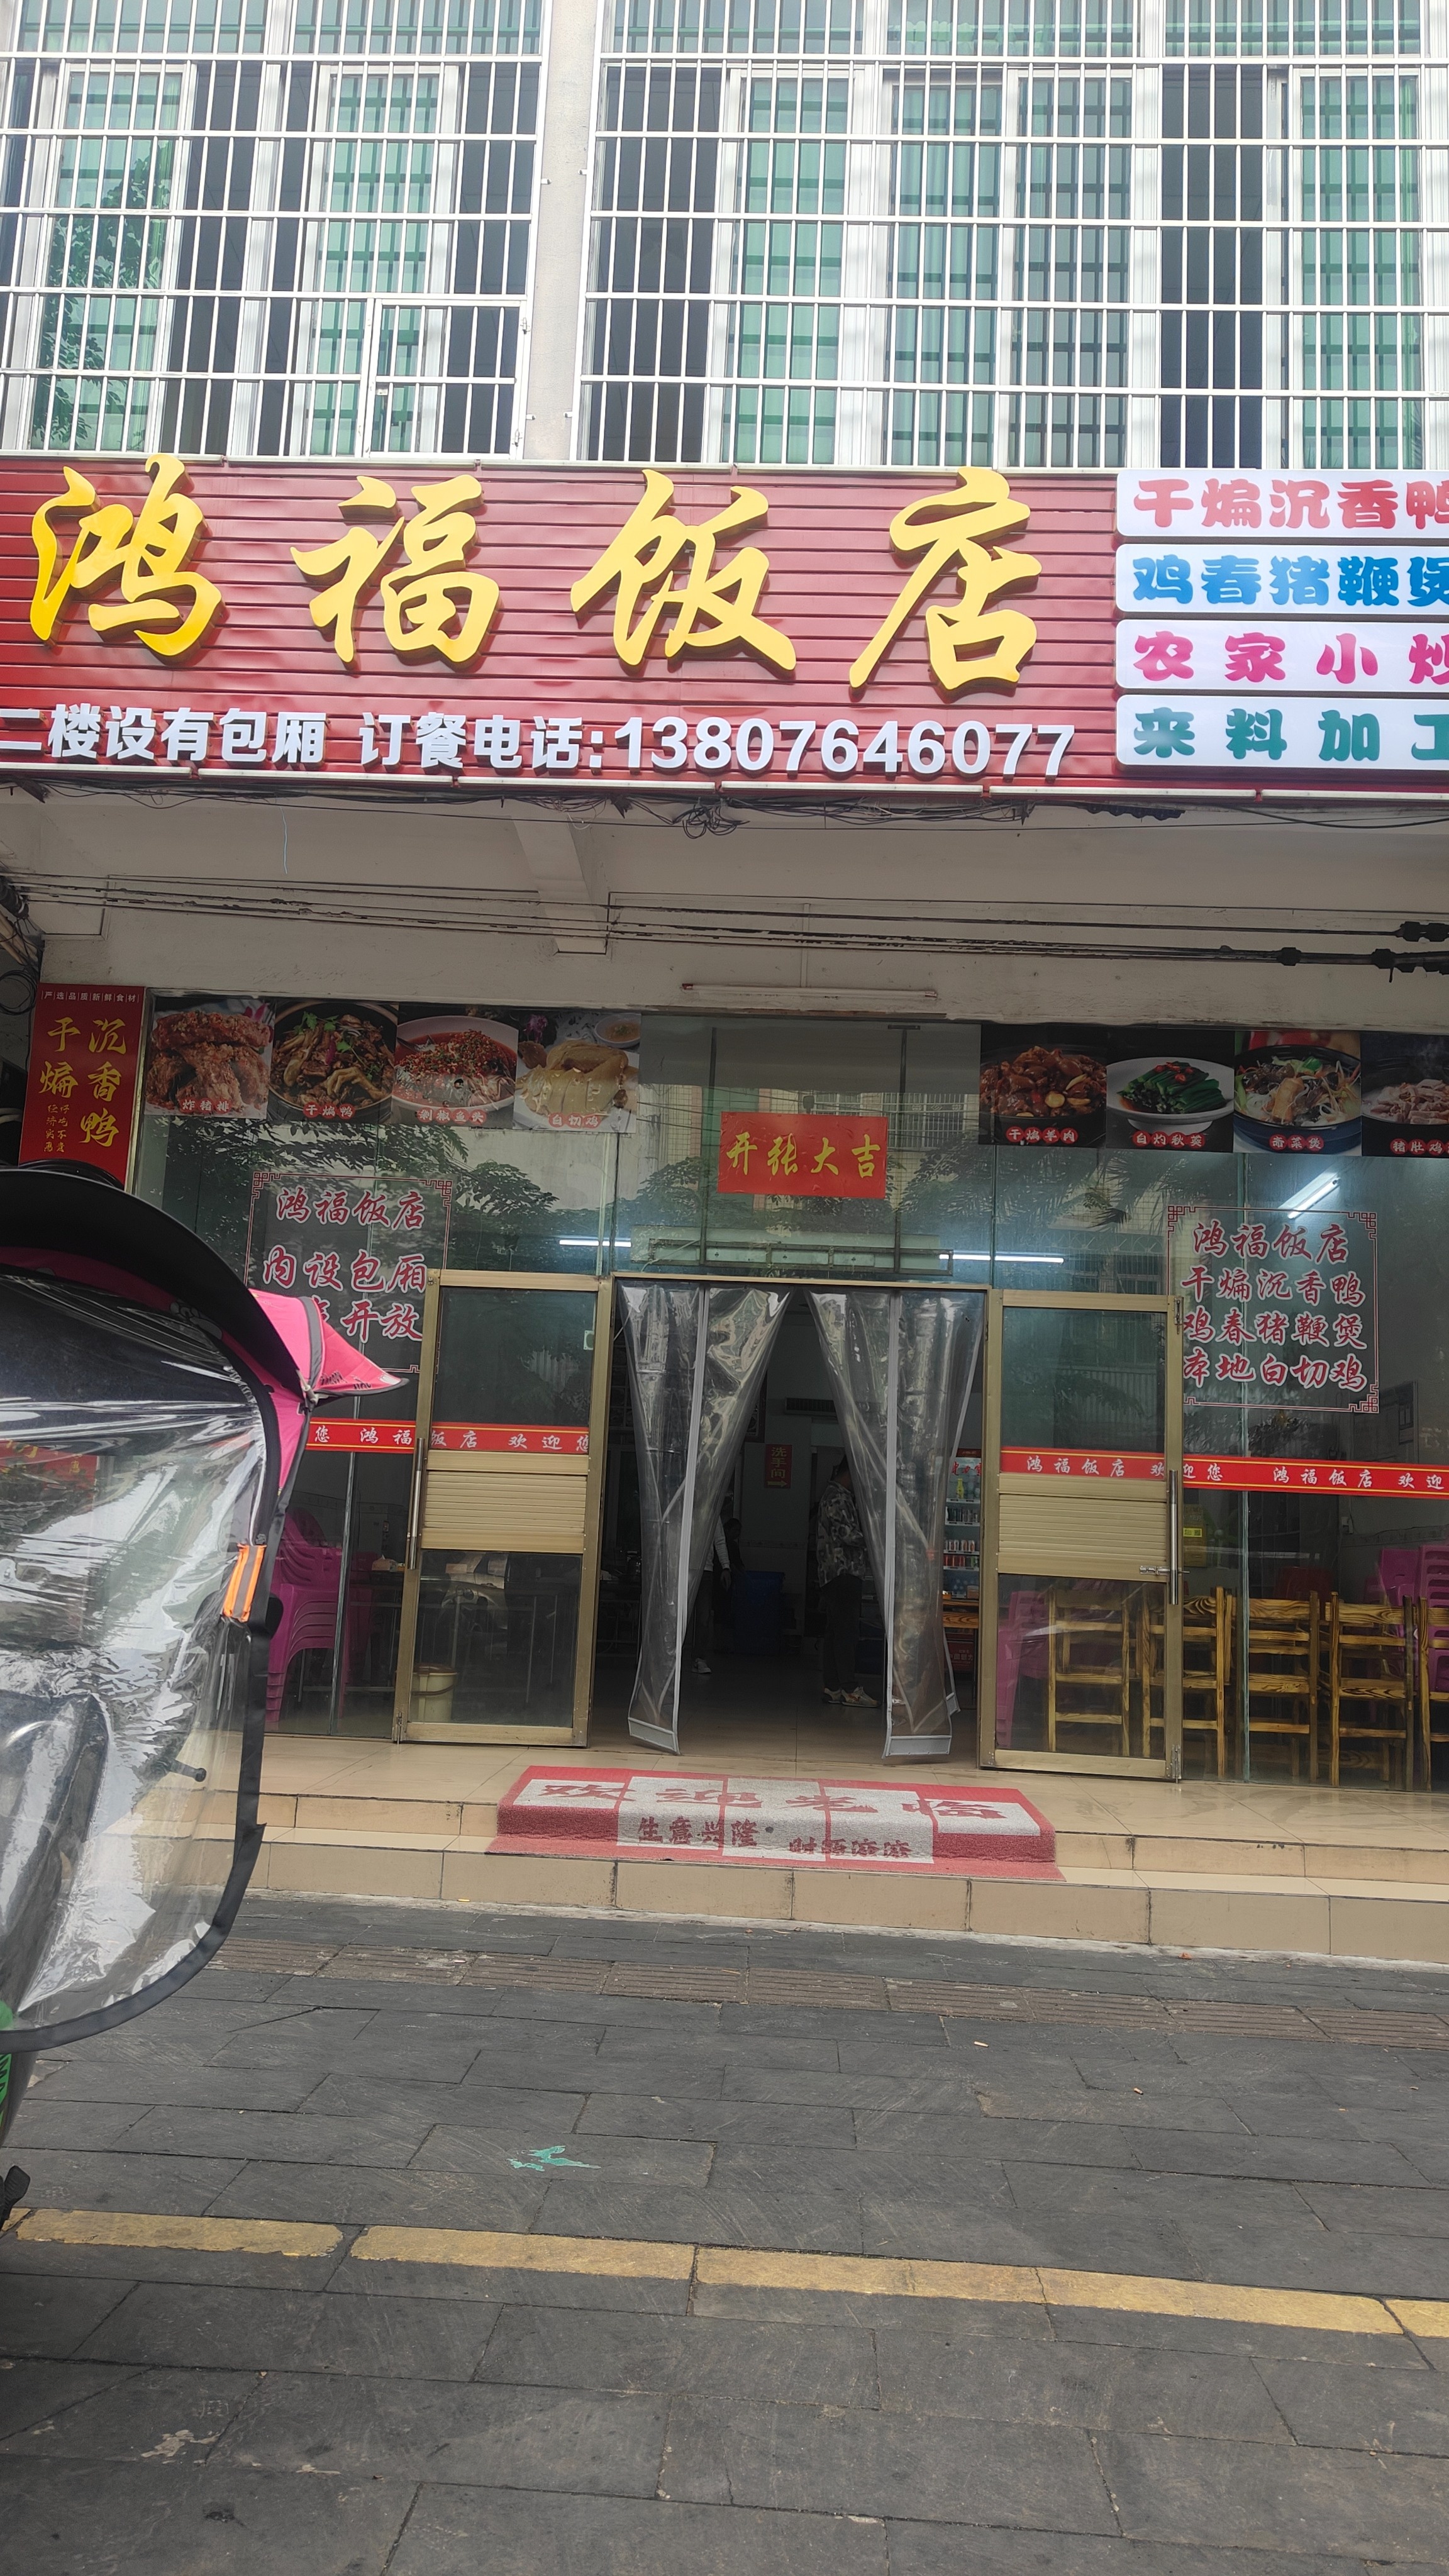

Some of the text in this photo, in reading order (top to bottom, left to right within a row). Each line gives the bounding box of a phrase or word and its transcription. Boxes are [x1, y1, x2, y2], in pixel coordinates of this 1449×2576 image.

[1133, 478, 1449, 530] 干煸沉香鸭
[30, 453, 1043, 689] 鸿福饭店
[1133, 554, 1449, 606] 鸡春猪鞭煲
[1133, 631, 1449, 684] 农家小炒
[0, 702, 327, 763] 二楼设有包厢
[1133, 708, 1449, 761] 来料加工
[182, 1099, 229, 1112] 炸猪排
[419, 1109, 484, 1123] 剁椒鱼头
[553, 1114, 599, 1127] 白切鸡
[727, 1131, 880, 1179] 开张大吉
[1136, 1133, 1202, 1147] 白灼秋葵
[1392, 1140, 1449, 1155] 猪肚鸡
[276, 1186, 426, 1231] 鸿福饭店
[1192, 1219, 1349, 1264] 鸿福饭店
[263, 1245, 428, 1294] 内设包厢
[1181, 1267, 1366, 1307] 干煸沉香鸭
[1183, 1307, 1367, 1350] 鸡春猪鞭煲
[1183, 1348, 1367, 1392] 本地白切鸡
[770, 1446, 787, 1479] 洗手间
[1026, 1455, 1125, 1478] 鸿福饭店
[1273, 1466, 1372, 1489] 鸿福饭店
[538, 1784, 1006, 1819] 欢迎光临
[638, 1815, 758, 1847] 生意兴隆
